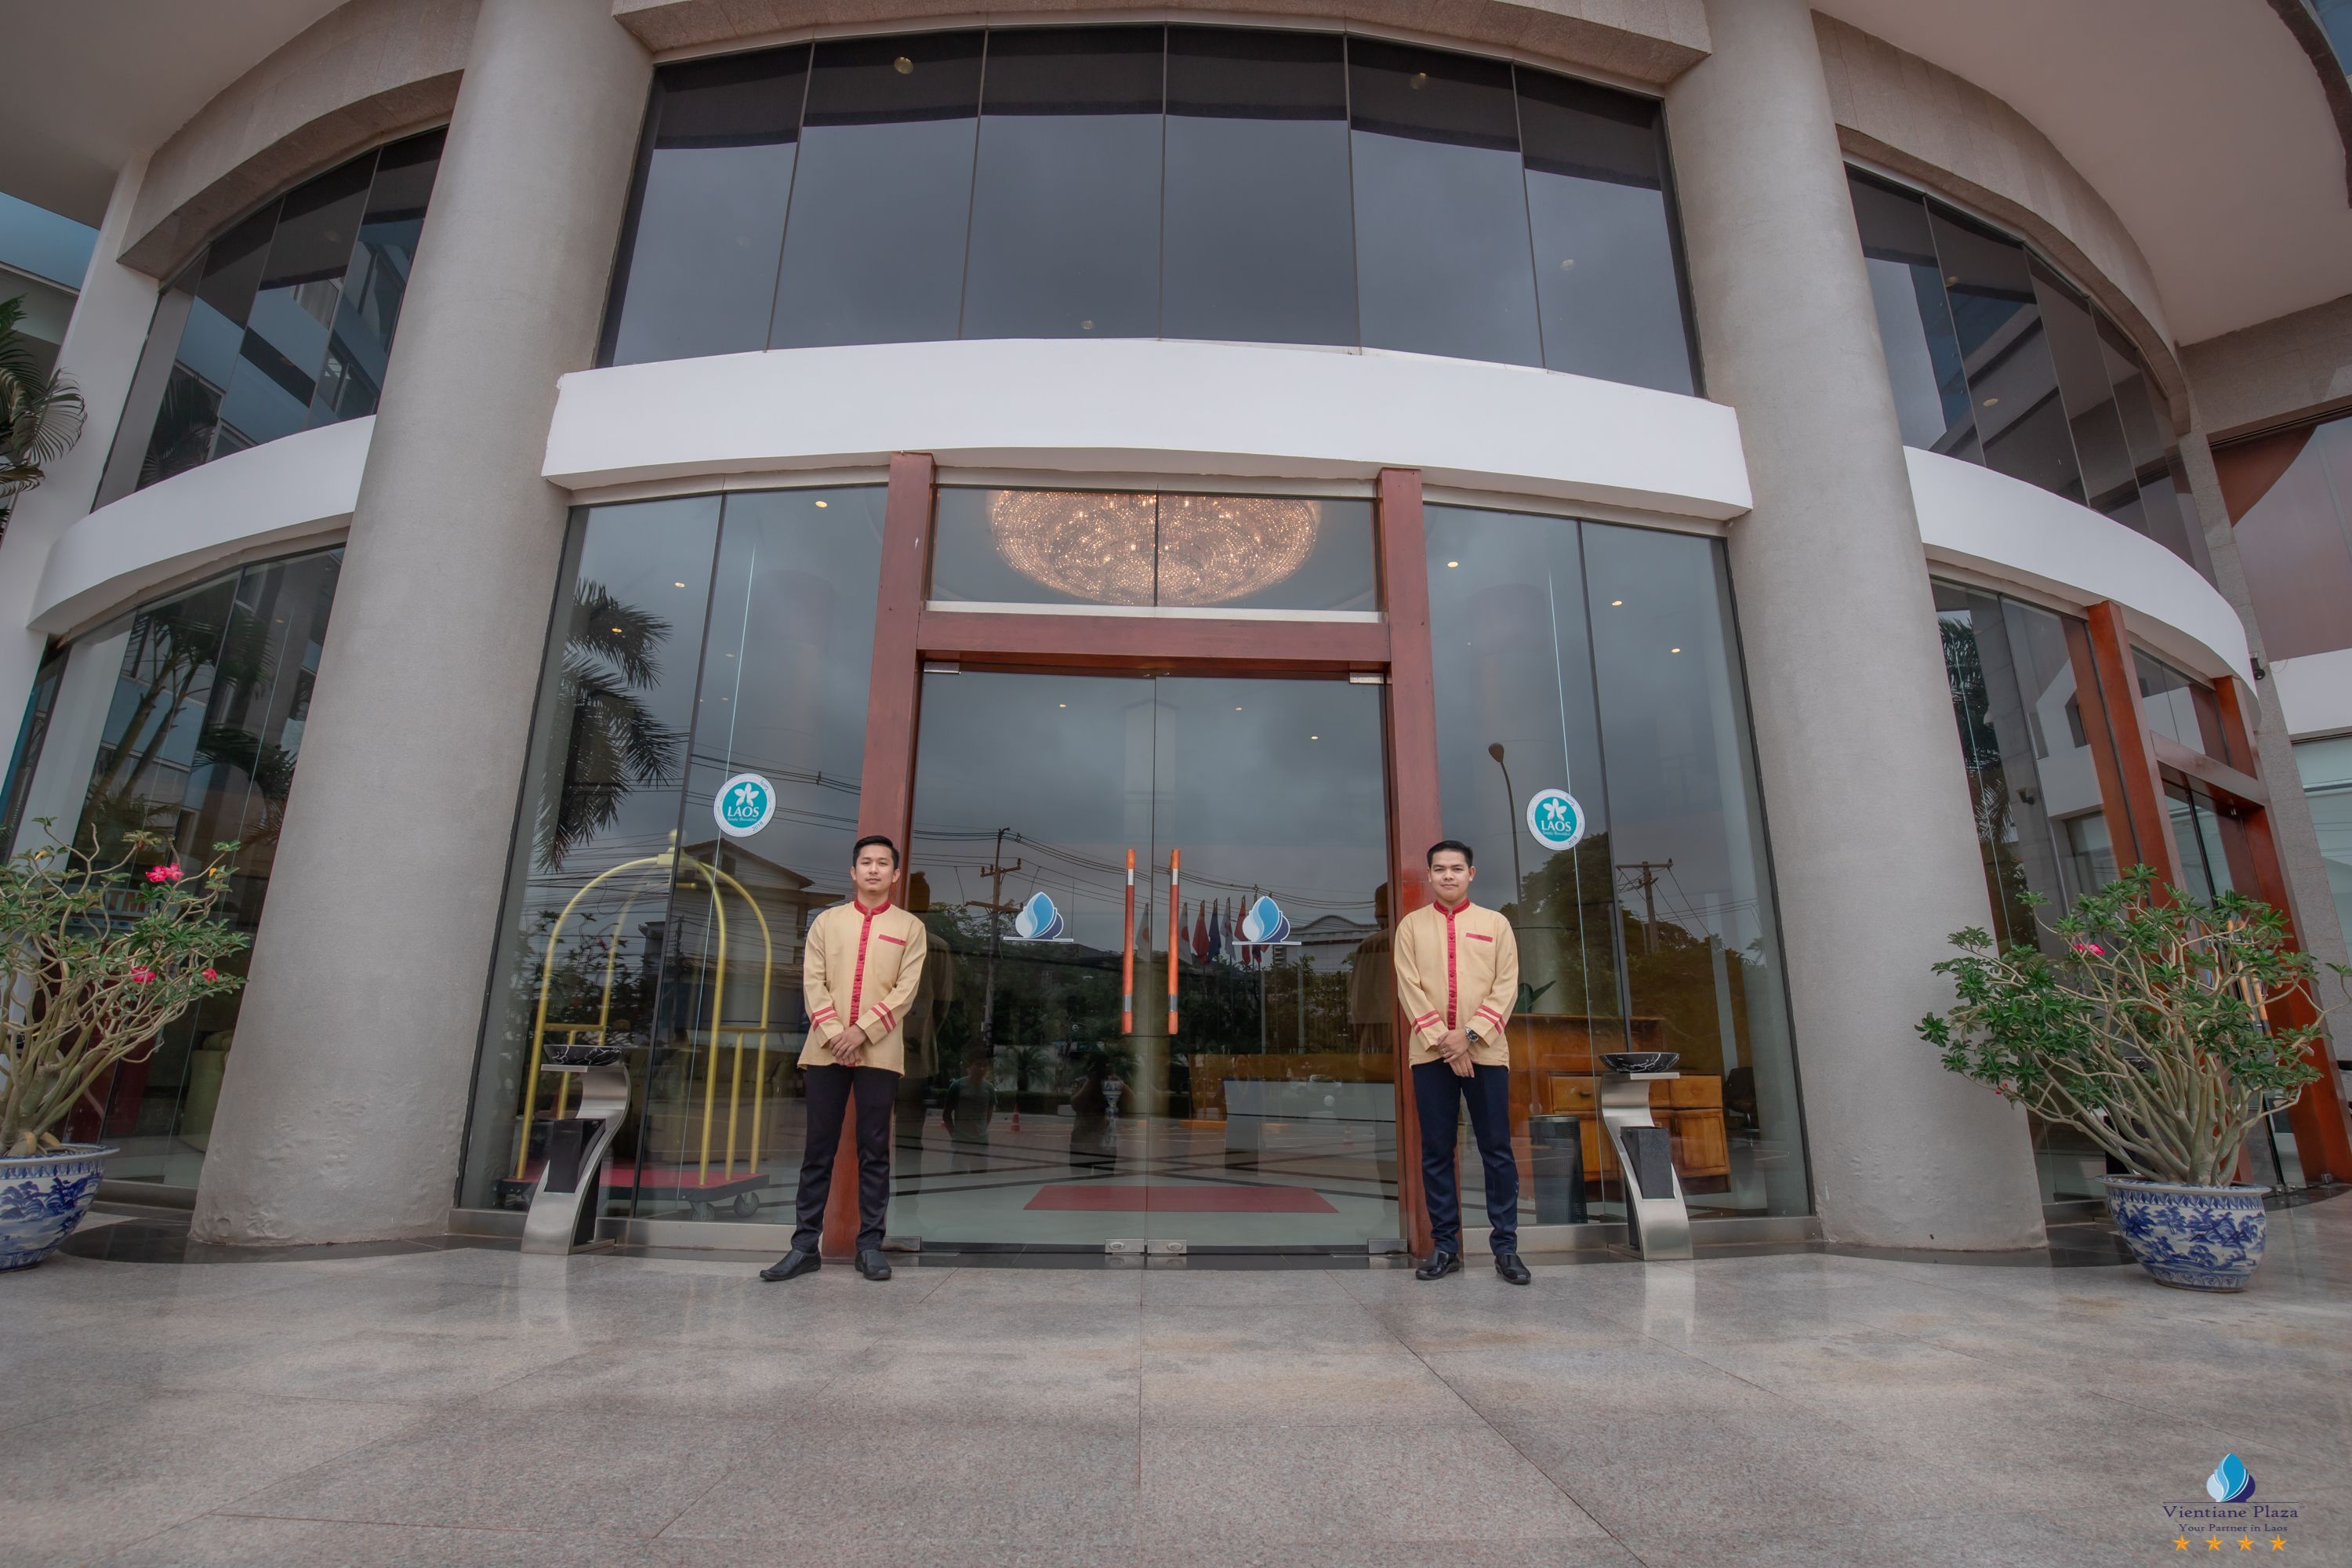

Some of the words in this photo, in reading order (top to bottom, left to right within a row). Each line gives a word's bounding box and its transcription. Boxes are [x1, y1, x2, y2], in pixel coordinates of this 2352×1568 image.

[728, 806, 760, 817] LAOS
[752, 821, 764, 831] 2018
[1541, 820, 1571, 832] LAOS
[103, 890, 147, 913] TM
